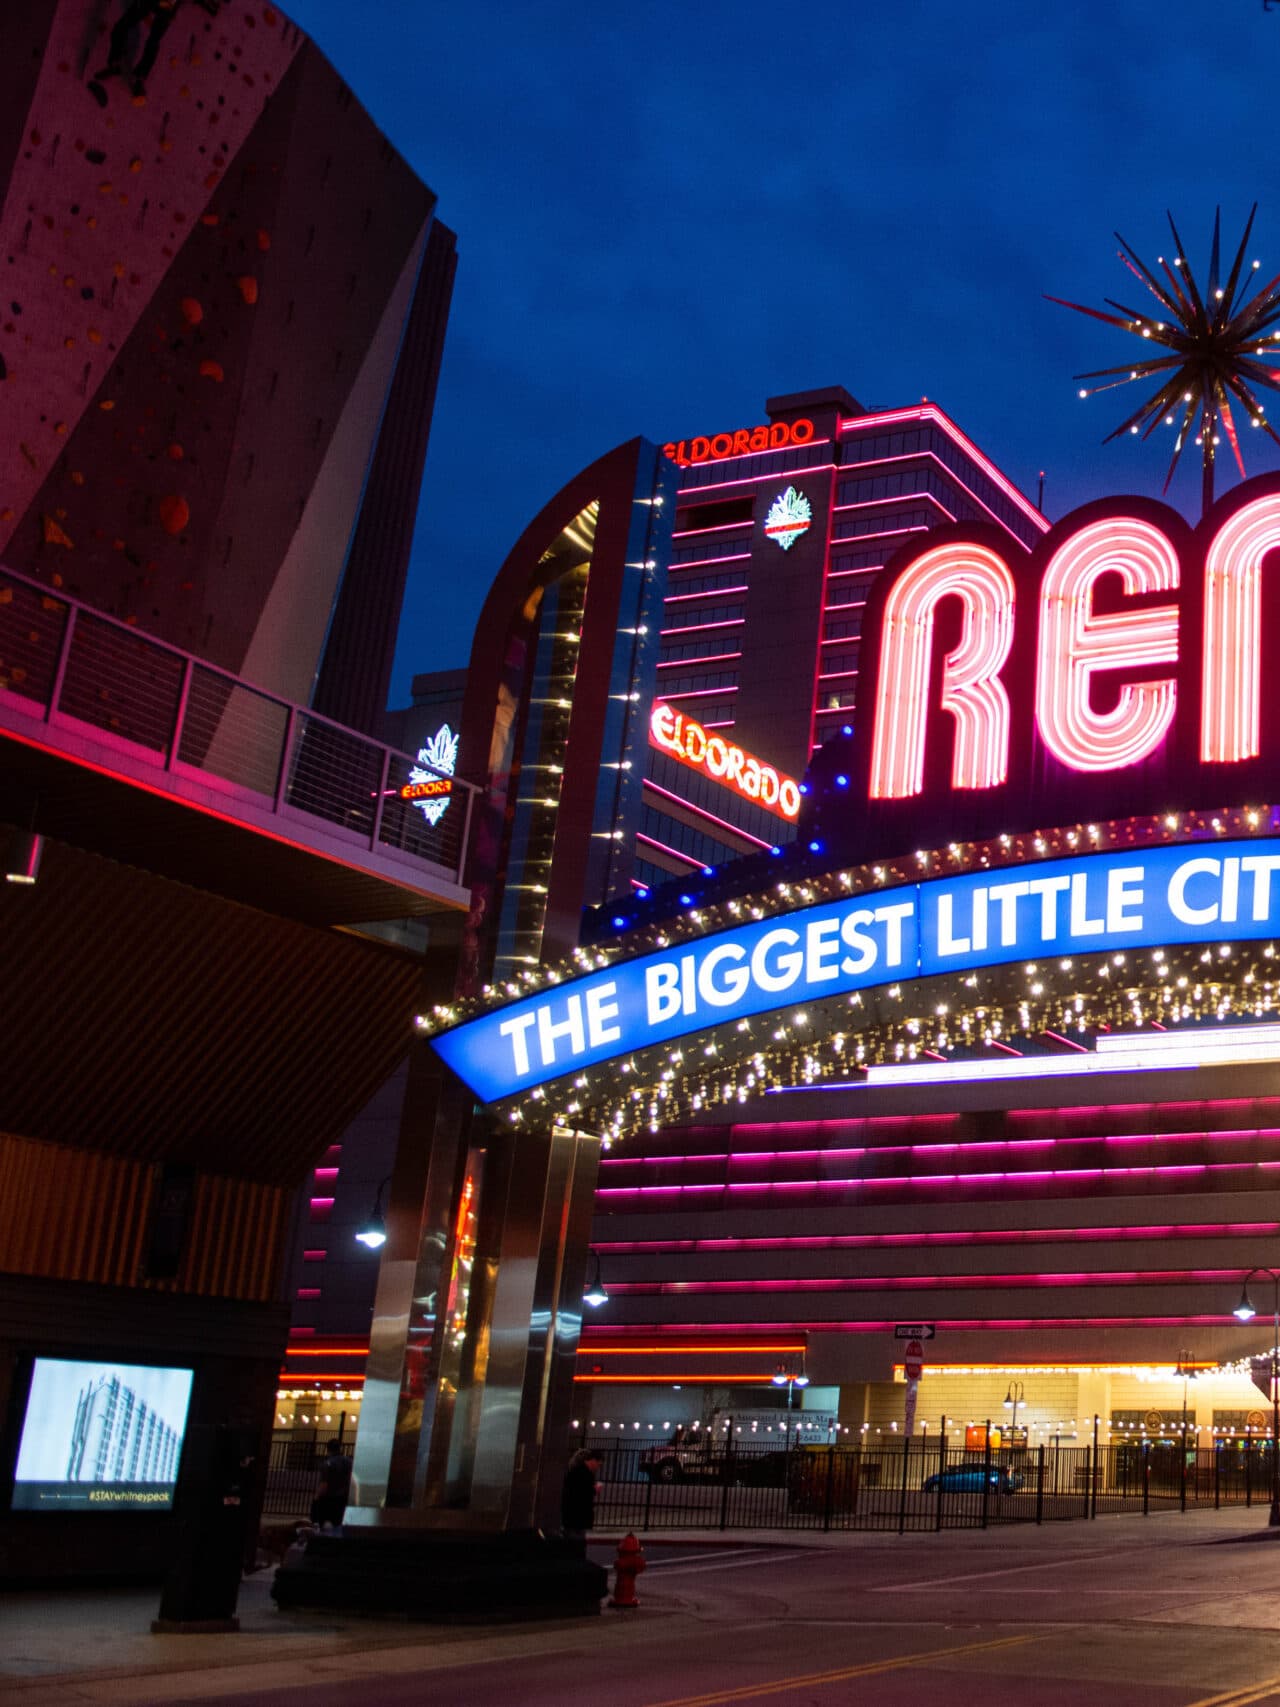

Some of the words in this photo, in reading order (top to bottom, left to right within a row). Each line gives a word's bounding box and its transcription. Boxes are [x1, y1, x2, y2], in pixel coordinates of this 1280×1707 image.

[500, 981, 622, 1076] THE
[645, 902, 915, 1025] BIGGEST
[937, 866, 1145, 956] LITTLE
